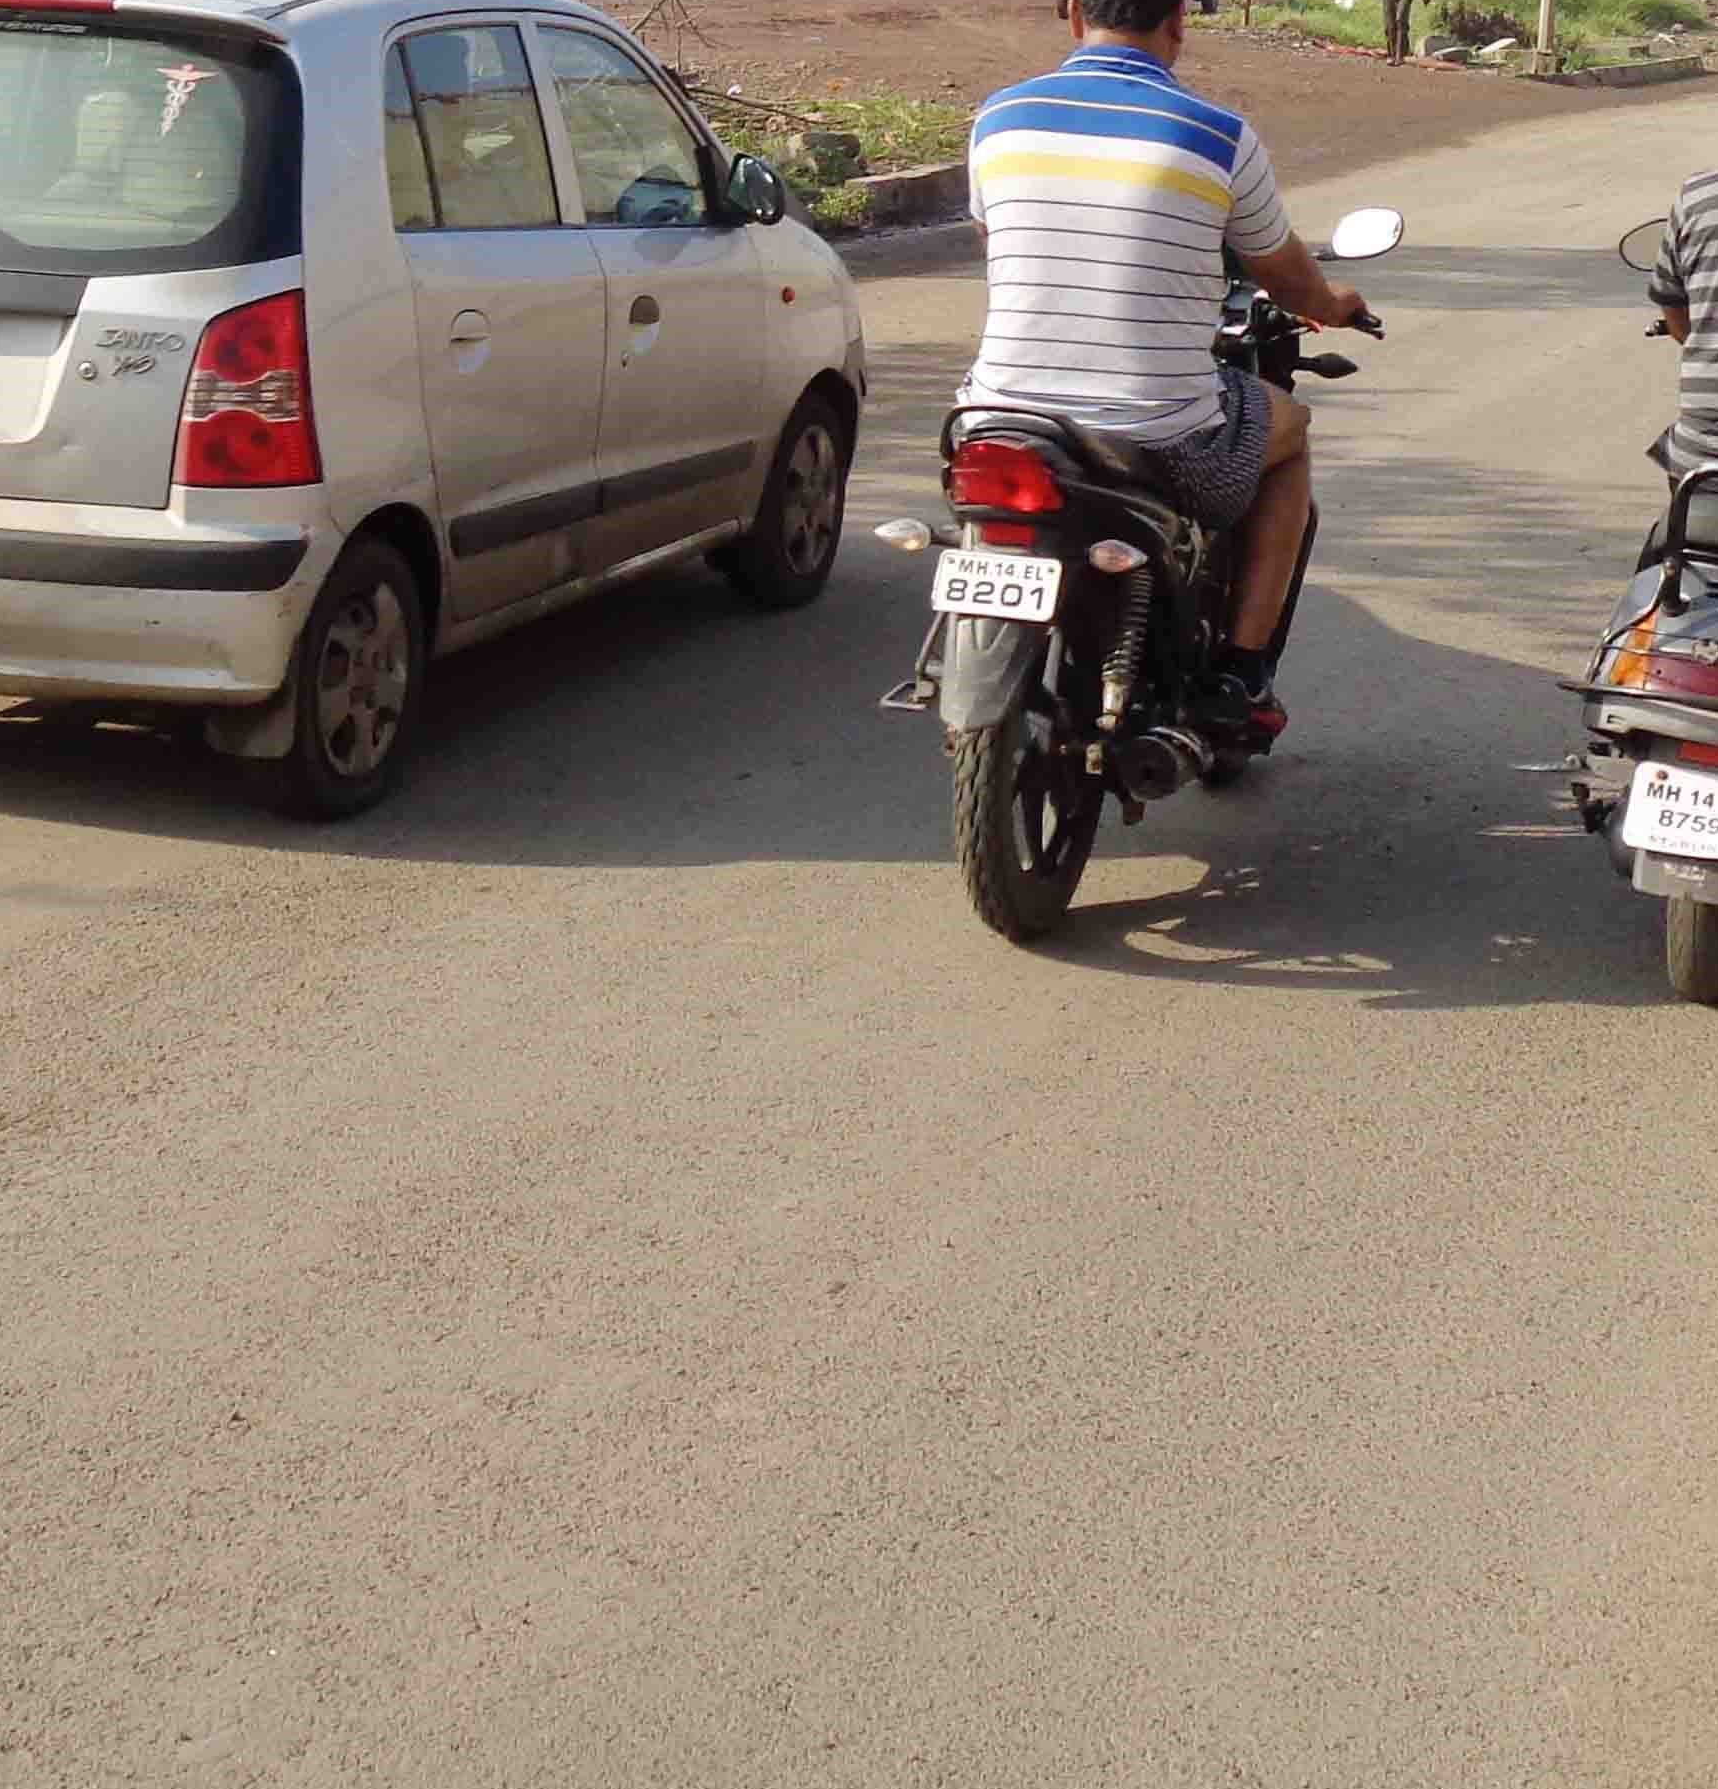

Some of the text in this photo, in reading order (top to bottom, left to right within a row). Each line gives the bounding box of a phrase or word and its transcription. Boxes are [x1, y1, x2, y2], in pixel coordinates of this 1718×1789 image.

[946, 577, 1046, 612] 8201
[1645, 781, 1682, 804] MH
[1689, 789, 1716, 809] 14
